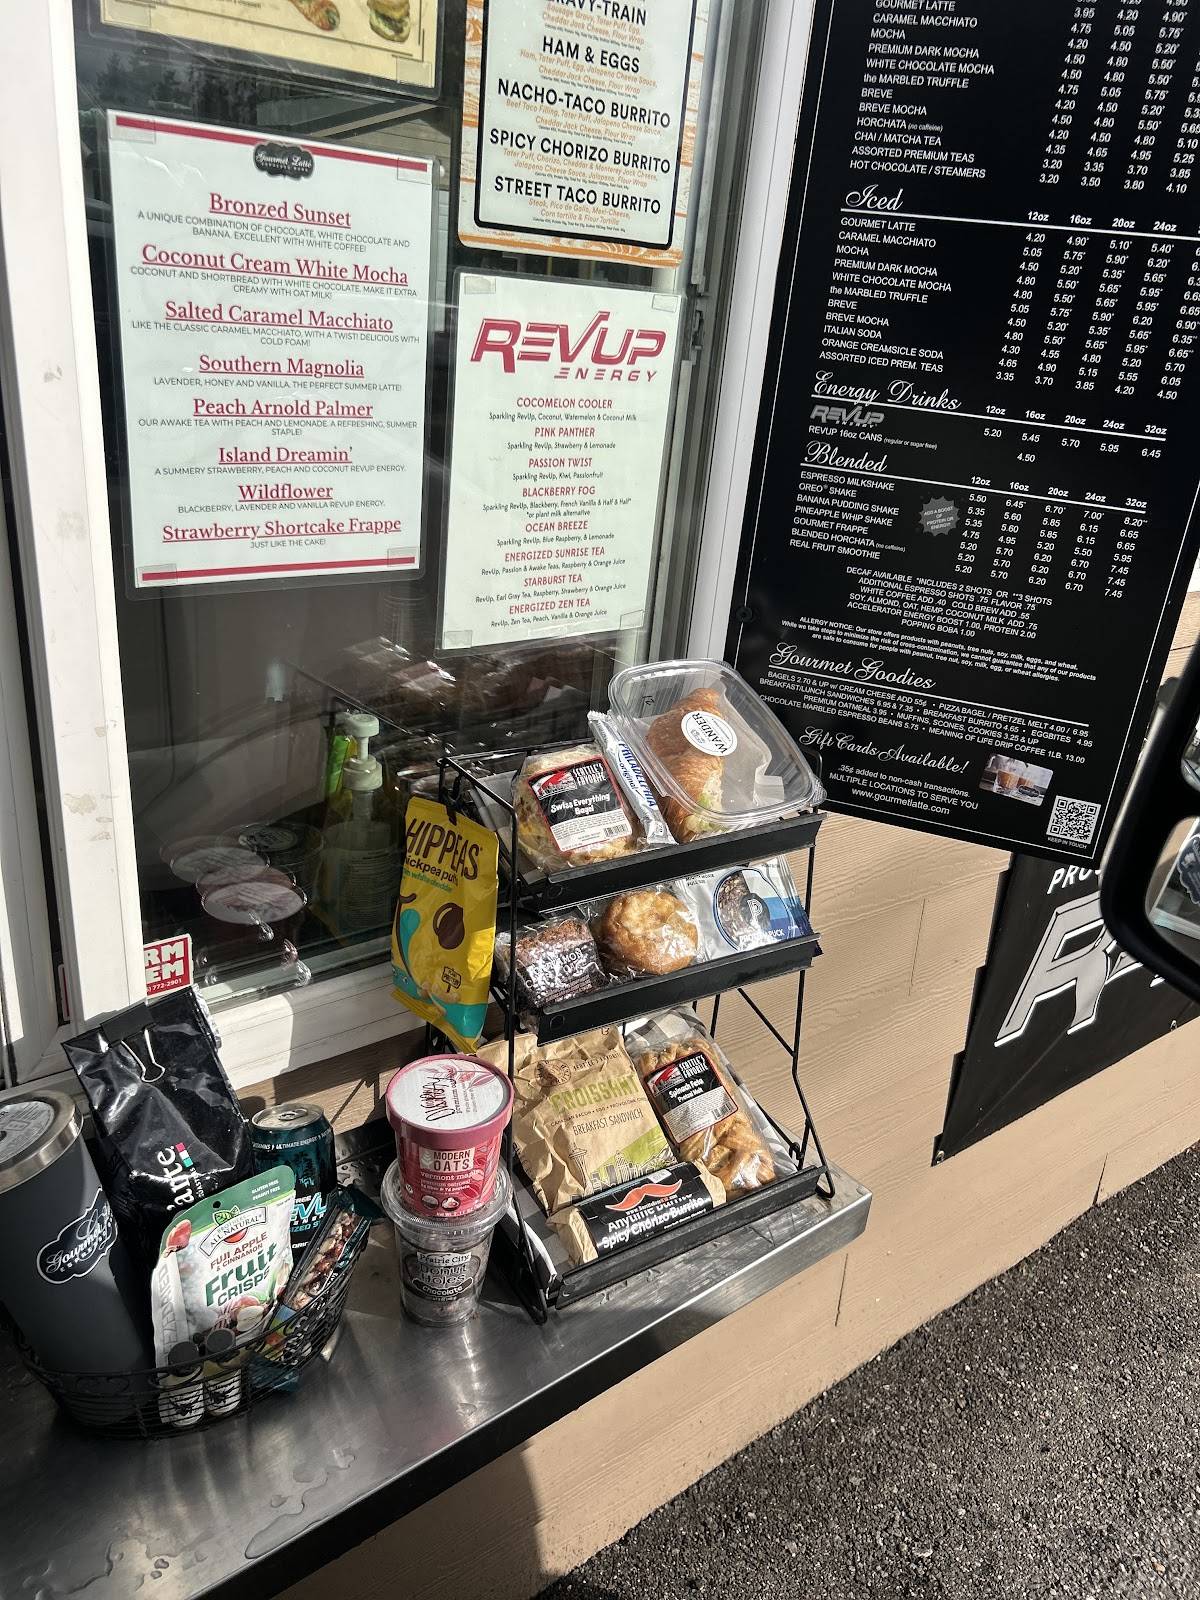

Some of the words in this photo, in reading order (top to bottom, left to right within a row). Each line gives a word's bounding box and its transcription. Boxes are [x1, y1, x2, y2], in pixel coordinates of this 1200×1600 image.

[548, 0, 646, 26] AVY-TRAIN
[543, 36, 579, 60] HAM
[585, 47, 594, 62] &
[601, 50, 640, 73] EGGS
[498, 79, 605, 114] NACHO-TACO
[611, 102, 670, 128] BURRITO
[256, 152, 288, 165] Gourmet
[292, 155, 312, 169] Latte
[490, 129, 536, 150] SPICY
[541, 138, 608, 162] CHORIZO
[614, 151, 670, 173] BURRITO
[1039, 173, 1059, 184] 3.20
[1081, 176, 1100, 187] 3.50
[1124, 179, 1144, 190] 3.80
[1166, 183, 1187, 193] 4.10
[495, 176, 552, 198] STREET
[557, 185, 597, 205] TACO
[603, 192, 660, 214] BURRITO
[846, 184, 903, 210] Iced
[210, 193, 288, 219] Bronzed
[294, 203, 351, 226] Sunset
[840, 217, 886, 229] GOURMET
[888, 221, 916, 231] LATTE
[1028, 211, 1049, 222] 12oz
[1070, 214, 1092, 225] 16oz
[1112, 218, 1135, 228] 20oz
[1153, 221, 1177, 232] 24oz
[143, 244, 226, 268] Coconut
[231, 252, 290, 274] Cream
[297, 260, 348, 279] White
[353, 264, 408, 284] Mocha
[834, 258, 876, 270] PREMIUM
[877, 263, 902, 273] DARK
[904, 265, 938, 276] MOCHA
[166, 301, 223, 321] Salted
[229, 305, 302, 326] Caramel
[309, 309, 393, 330] Macchiato
[470, 311, 666, 373] REVUP
[200, 355, 281, 373] Southern
[287, 359, 364, 378] Magnolia
[554, 367, 657, 381] ENERGY
[205, 379, 234, 387] HONEY
[292, 381, 308, 389] THE
[310, 381, 342, 389] PERFECT
[345, 382, 377, 390] SUMMER
[814, 370, 880, 406] Energy
[888, 379, 962, 410] Drinks
[193, 398, 246, 415] Peach
[252, 400, 310, 416] Arnold
[316, 401, 373, 417] Palmer
[517, 397, 575, 409] COCOMELON
[578, 399, 612, 409] COOLER
[810, 405, 885, 424] REVUP
[535, 427, 556, 437] PINK
[559, 427, 595, 437] PANTHER
[809, 425, 837, 436] REVUP
[840, 430, 857, 439] 16oz
[859, 432, 882, 442] CANS
[219, 447, 271, 463] Island
[276, 446, 353, 463] Dreamin'
[507, 442, 532, 451] Sparkling
[804, 440, 887, 472] Blended
[528, 458, 565, 468] PASSION
[568, 458, 592, 467] TWIST
[522, 486, 575, 497] BLACKBERRY
[578, 486, 596, 495] FOG
[800, 471, 845, 484] ESPRESSO
[847, 477, 895, 491] MILKSHAKE
[239, 484, 333, 500] Wildflower
[163, 523, 260, 542] Strawberry
[265, 519, 345, 536] Shortcake
[349, 518, 401, 535] Frappe
[525, 522, 554, 533] OCEAN
[557, 521, 588, 531] BREEZE
[505, 550, 553, 562] ENERGIZED
[555, 548, 589, 558] SUNRISE
[592, 547, 605, 556] TEA
[524, 575, 566, 587] STARBURST
[568, 574, 582, 583] TEA
[509, 601, 555, 614] ENERGIZED
[558, 600, 574, 609] ZEN
[576, 598, 590, 607] TEA
[769, 642, 853, 675] Gourmet
[854, 658, 936, 689] Goodies
[692, 712, 728, 754] WANDER
[799, 726, 834, 750] Gift
[834, 734, 880, 757] Cards
[878, 744, 970, 774] Available!
[573, 763, 603, 777] SEATTLE'S
[576, 772, 606, 786] FAVORITE
[618, 740, 657, 807] PHILADELPHIA
[620, 762, 636, 790] original
[829, 772, 868, 786] MULTIPLE
[869, 781, 915, 797] LOCATIONS
[917, 790, 928, 799] TO
[930, 793, 958, 806] SERVE
[960, 799, 978, 810] YOU
[852, 788, 950, 815] www.gourmetlatte.com
[551, 802, 573, 813] Swiss
[573, 793, 610, 807] Everything
[575, 805, 594, 815] Bagel
[407, 818, 480, 880] HIPPEAS
[144, 941, 184, 967] RM
[145, 960, 184, 983] EM
[683, 1061, 708, 1078] FAVORITE
[549, 1074, 639, 1115] CROISSANT
[669, 1083, 692, 1099] Spinach
[690, 1078, 704, 1089] Feta
[573, 1117, 608, 1136] BREAKFAST
[608, 1108, 644, 1126] SANDWICH
[433, 1150, 470, 1160] MODERN
[434, 1159, 470, 1171] OATS
[421, 1171, 454, 1180] vermont
[252, 1184, 268, 1194] GLUTEN
[210, 1233, 221, 1247] ALL
[223, 1217, 259, 1235] NATURAL
[602, 1229, 630, 1249] Spicy
[631, 1212, 669, 1235] Chorizo
[670, 1197, 704, 1218] Burrito
[210, 1252, 230, 1270] FUJI
[234, 1232, 268, 1255] APPLE
[222, 1243, 263, 1268] CINNAMON
[420, 1254, 450, 1263] Prairie
[452, 1254, 469, 1262] City
[206, 1242, 277, 1307] Fruit
[421, 1272, 466, 1284] Holes
[218, 1266, 270, 1306] CRISPS
[423, 1286, 462, 1295] chocolate
